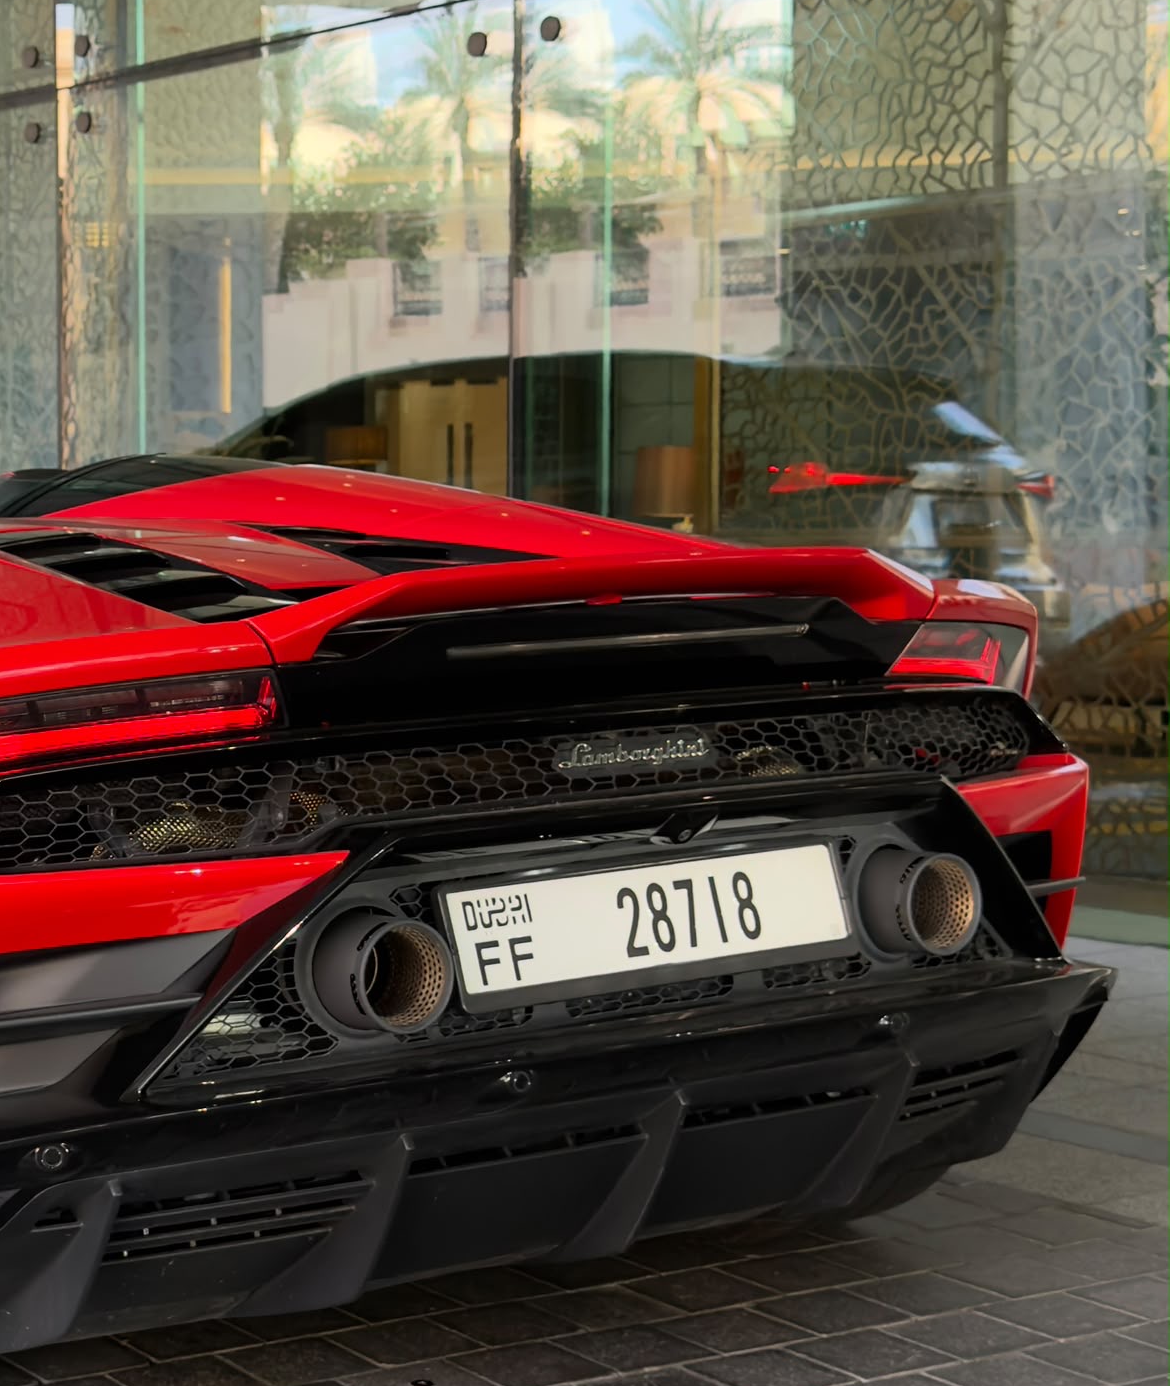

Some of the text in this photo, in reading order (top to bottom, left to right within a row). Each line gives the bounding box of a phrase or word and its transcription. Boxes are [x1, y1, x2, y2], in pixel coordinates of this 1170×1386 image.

[557, 737, 710, 769] Lamborghini
[616, 871, 762, 958] 28718
[474, 935, 534, 987] FF
